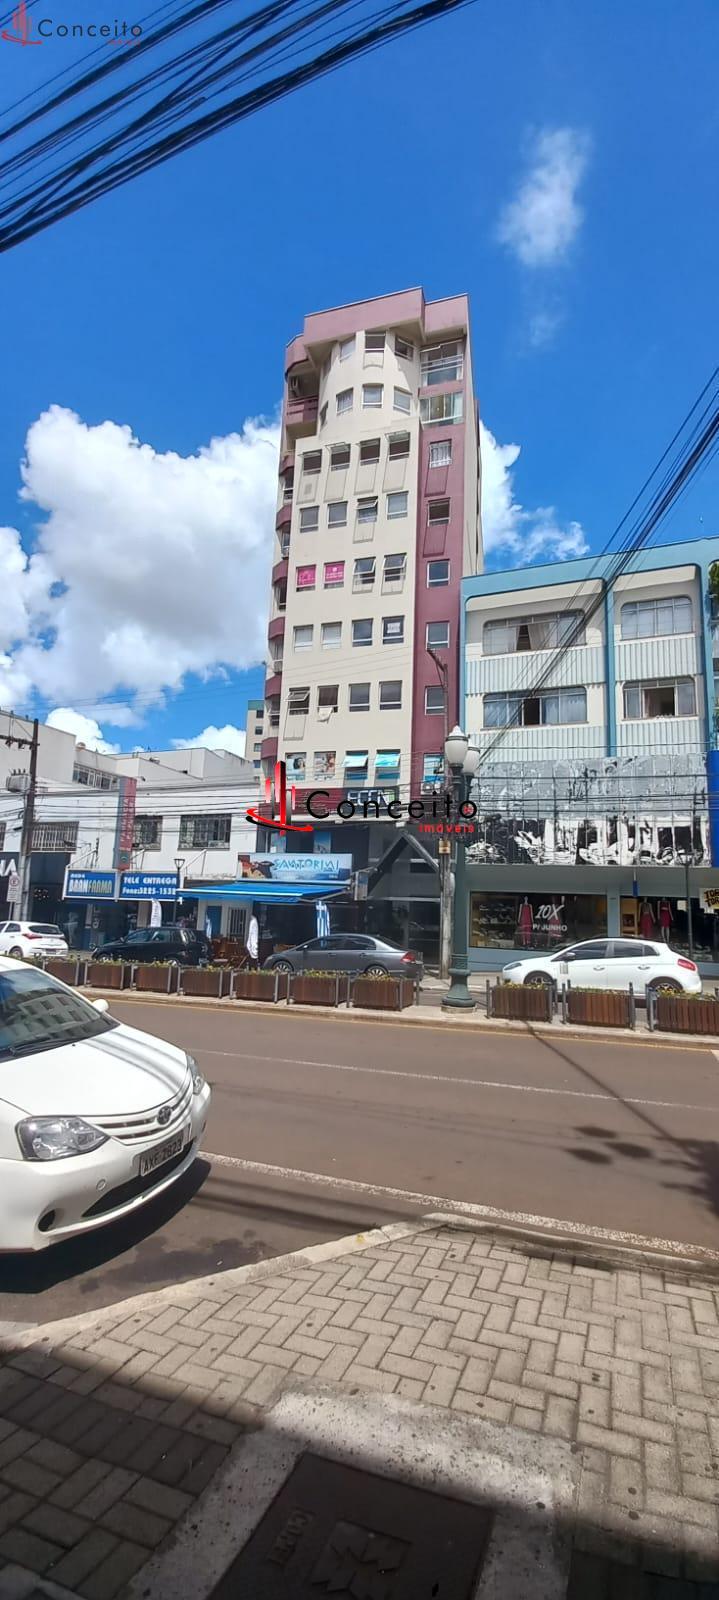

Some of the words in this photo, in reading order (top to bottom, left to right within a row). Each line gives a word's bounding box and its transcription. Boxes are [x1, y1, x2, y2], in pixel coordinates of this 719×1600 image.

[123, 876, 140, 884] TELE
[142, 876, 177, 885] ENTREGA
[535, 903, 565, 921] 10X
